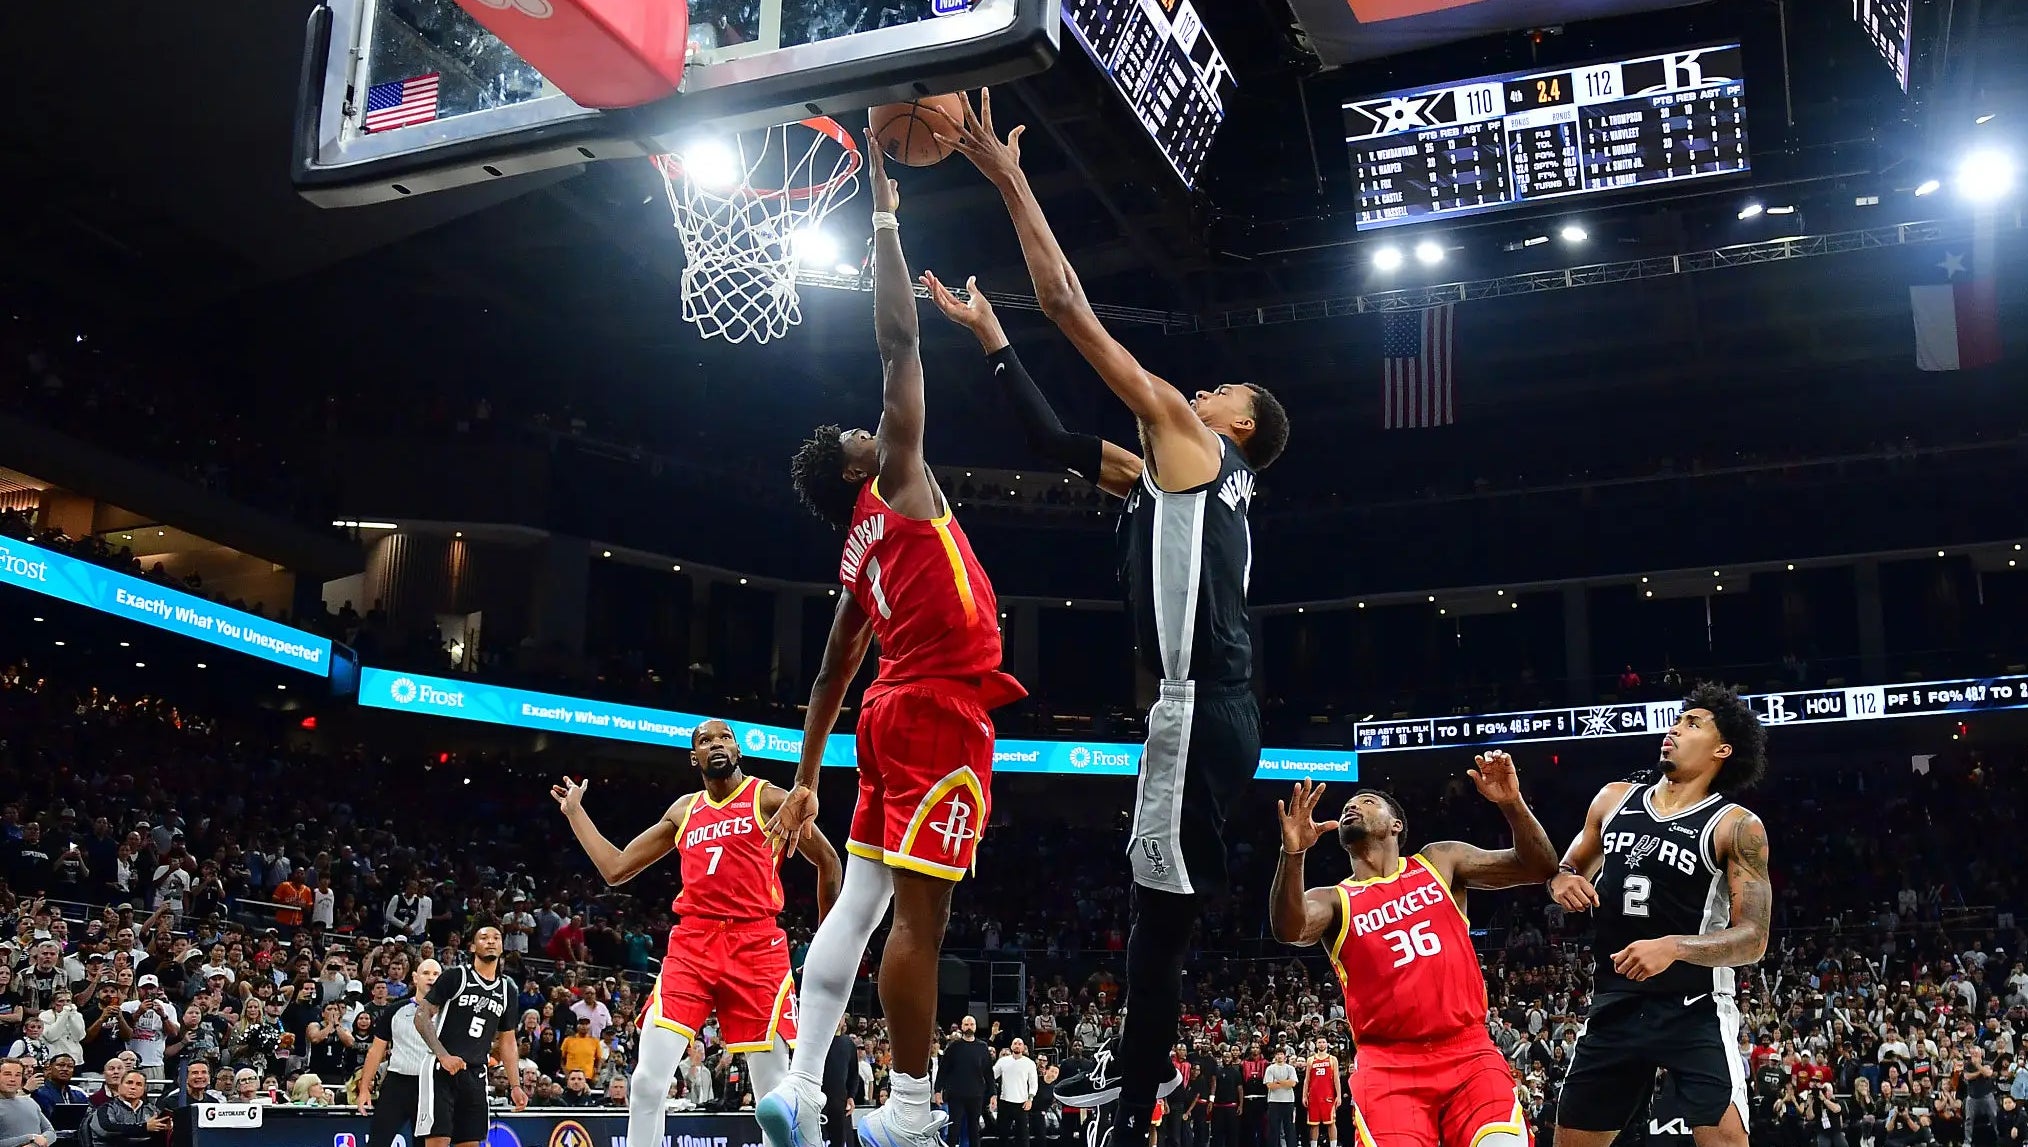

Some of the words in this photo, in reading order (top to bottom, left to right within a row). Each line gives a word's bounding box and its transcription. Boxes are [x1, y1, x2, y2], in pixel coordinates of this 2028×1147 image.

[1467, 89, 1492, 115] 110
[1537, 79, 1560, 102] 2.4
[1586, 71, 1612, 97] 112
[1652, 95, 1673, 105] PTS
[1676, 91, 1696, 102] REB
[1700, 88, 1720, 99] AST
[1726, 85, 1740, 95] PF
[1588, 118, 1592, 129] 1
[1608, 111, 1642, 126] THOMPSON
[1709, 100, 1715, 111] 4
[1417, 130, 1437, 141] PTS
[1440, 127, 1459, 137] REB
[1462, 123, 1482, 134] AST
[1487, 121, 1500, 130] PF
[1609, 127, 1639, 141] VANVLEET
[1356, 153, 1362, 163] 1
[1492, 133, 1498, 143] 4
[1535, 140, 1552, 149] TOL
[1590, 148, 1596, 159] 7
[1688, 134, 1694, 145] 7
[1378, 162, 1402, 175] HARPER
[1495, 148, 1500, 158] 1
[1533, 160, 1559, 170] 3PT%
[1612, 158, 1633, 171] SMITH
[1666, 152, 1671, 163] 7
[1713, 145, 1718, 156] 1
[1736, 142, 1742, 153] 4
[1359, 182, 1365, 192] 4
[1379, 178, 1392, 189] FOX
[1452, 168, 1458, 179] 4
[1496, 162, 1501, 172] 1
[1533, 179, 1562, 190] TURNS
[1537, 170, 1557, 179] FT%
[1381, 191, 1403, 204] CASTLE
[1430, 186, 1438, 197] 15
[1453, 183, 1459, 193] 7
[1455, 198, 1461, 208] 4
[1499, 191, 1505, 201] 4
[842, 514, 884, 583] THOMPSON
[116, 588, 173, 620] Exactly
[175, 605, 213, 631] What
[215, 618, 240, 639] You
[243, 628, 319, 663] Unexpected
[419, 684, 464, 707] Frost
[522, 703, 572, 723] Exactly
[574, 710, 610, 727] What
[612, 715, 636, 730] You
[1806, 697, 1841, 716] HOU
[1852, 692, 1876, 715] 112
[1888, 694, 1908, 706] PF
[1913, 691, 1921, 705] 5
[1928, 690, 1964, 703] FG%
[1965, 685, 1986, 701] 48.7
[1990, 686, 2013, 698] TO
[2020, 682, 2028, 698] 2
[1438, 726, 1457, 737] TO
[1463, 723, 1470, 737] 0
[1476, 722, 1507, 735] FG%
[1510, 719, 1530, 733] 48.5
[1532, 719, 1551, 731] PF
[1557, 716, 1564, 731] 5
[1621, 711, 1645, 728] SA
[1653, 707, 1674, 728] 110
[1363, 736, 1372, 747] 47
[1381, 735, 1389, 746] 21
[1399, 734, 1407, 745] 10
[1396, 726, 1411, 734] STL
[1092, 751, 1130, 766] Frost
[1281, 760, 1349, 772] Unexpected
[686, 816, 753, 849] ROCKETS
[705, 846, 723, 875] 7
[1603, 832, 1697, 876] SPURS
[1623, 874, 1652, 917] 2
[1353, 882, 1444, 937] ROCKETS
[1382, 920, 1442, 968] 36
[458, 994, 504, 1017] SPURS
[468, 1016, 487, 1038] 5
[206, 1107, 216, 1121] G
[248, 1107, 257, 1119] G
